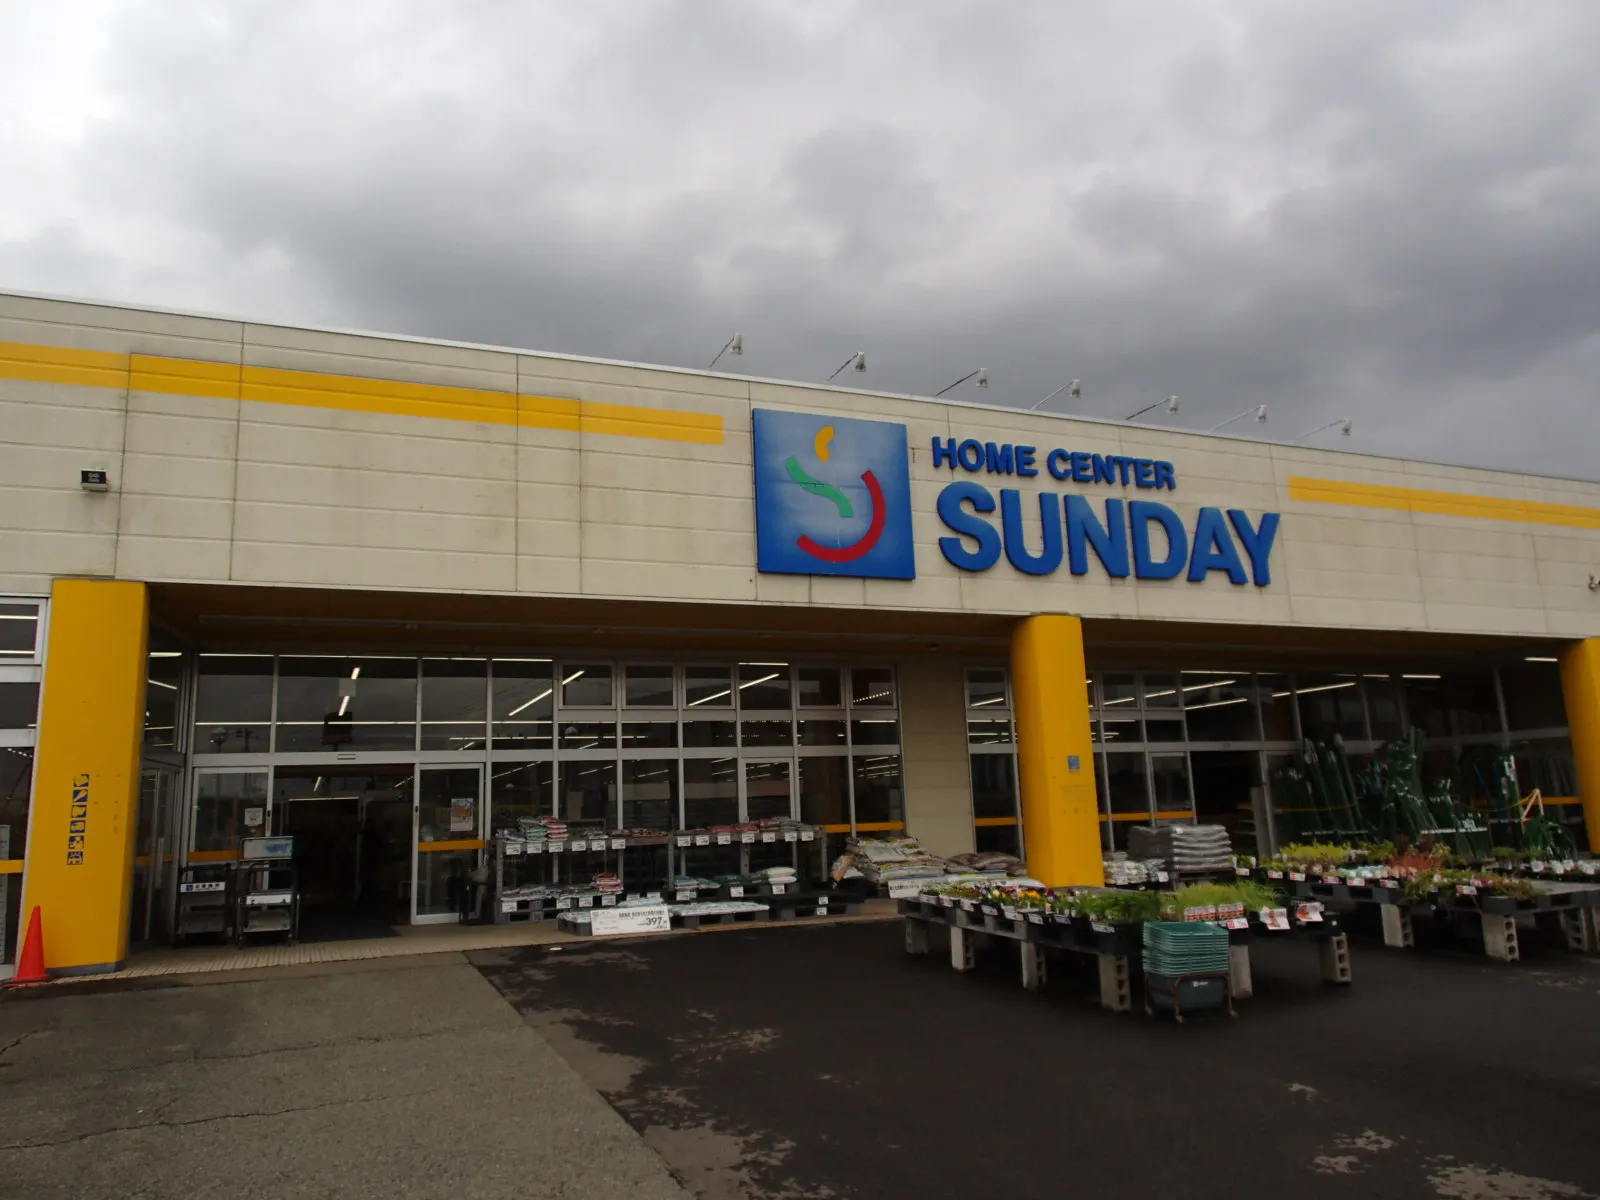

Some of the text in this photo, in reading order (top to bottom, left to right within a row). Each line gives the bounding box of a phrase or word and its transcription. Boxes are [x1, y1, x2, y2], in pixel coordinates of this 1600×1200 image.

[932, 437, 1177, 490] HOME CENTER
[936, 481, 1281, 586] SUNDAY
